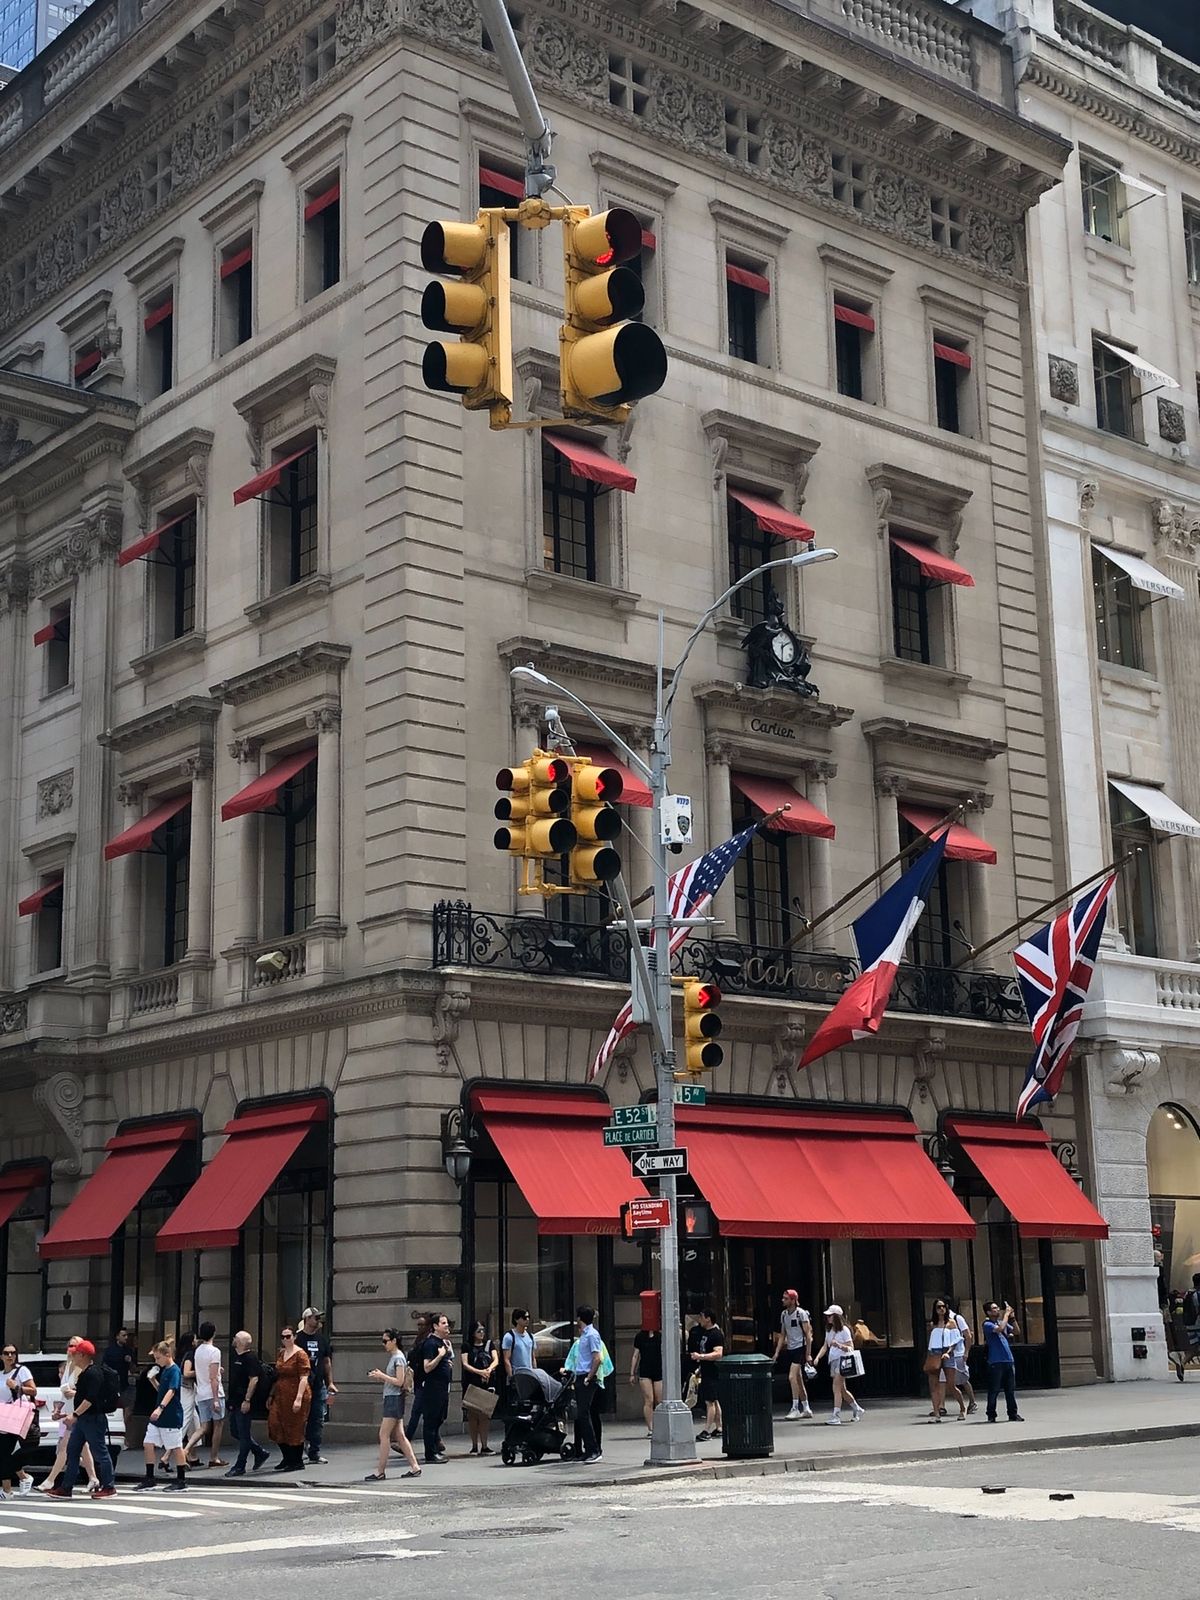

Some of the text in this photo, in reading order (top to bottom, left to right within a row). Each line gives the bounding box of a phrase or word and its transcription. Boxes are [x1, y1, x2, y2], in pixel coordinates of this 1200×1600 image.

[1140, 579, 1175, 595] VERSACE
[751, 718, 796, 739] Cartier
[1160, 819, 1196, 834] VERSACE
[747, 957, 842, 990] Cartier
[684, 1087, 691, 1102] 5
[615, 1107, 648, 1124] E 52 ST
[605, 1131, 623, 1143] PLACE
[632, 1129, 655, 1141] CARTIER
[640, 1156, 680, 1169] ONE WAY
[355, 1281, 379, 1295] Cartier
